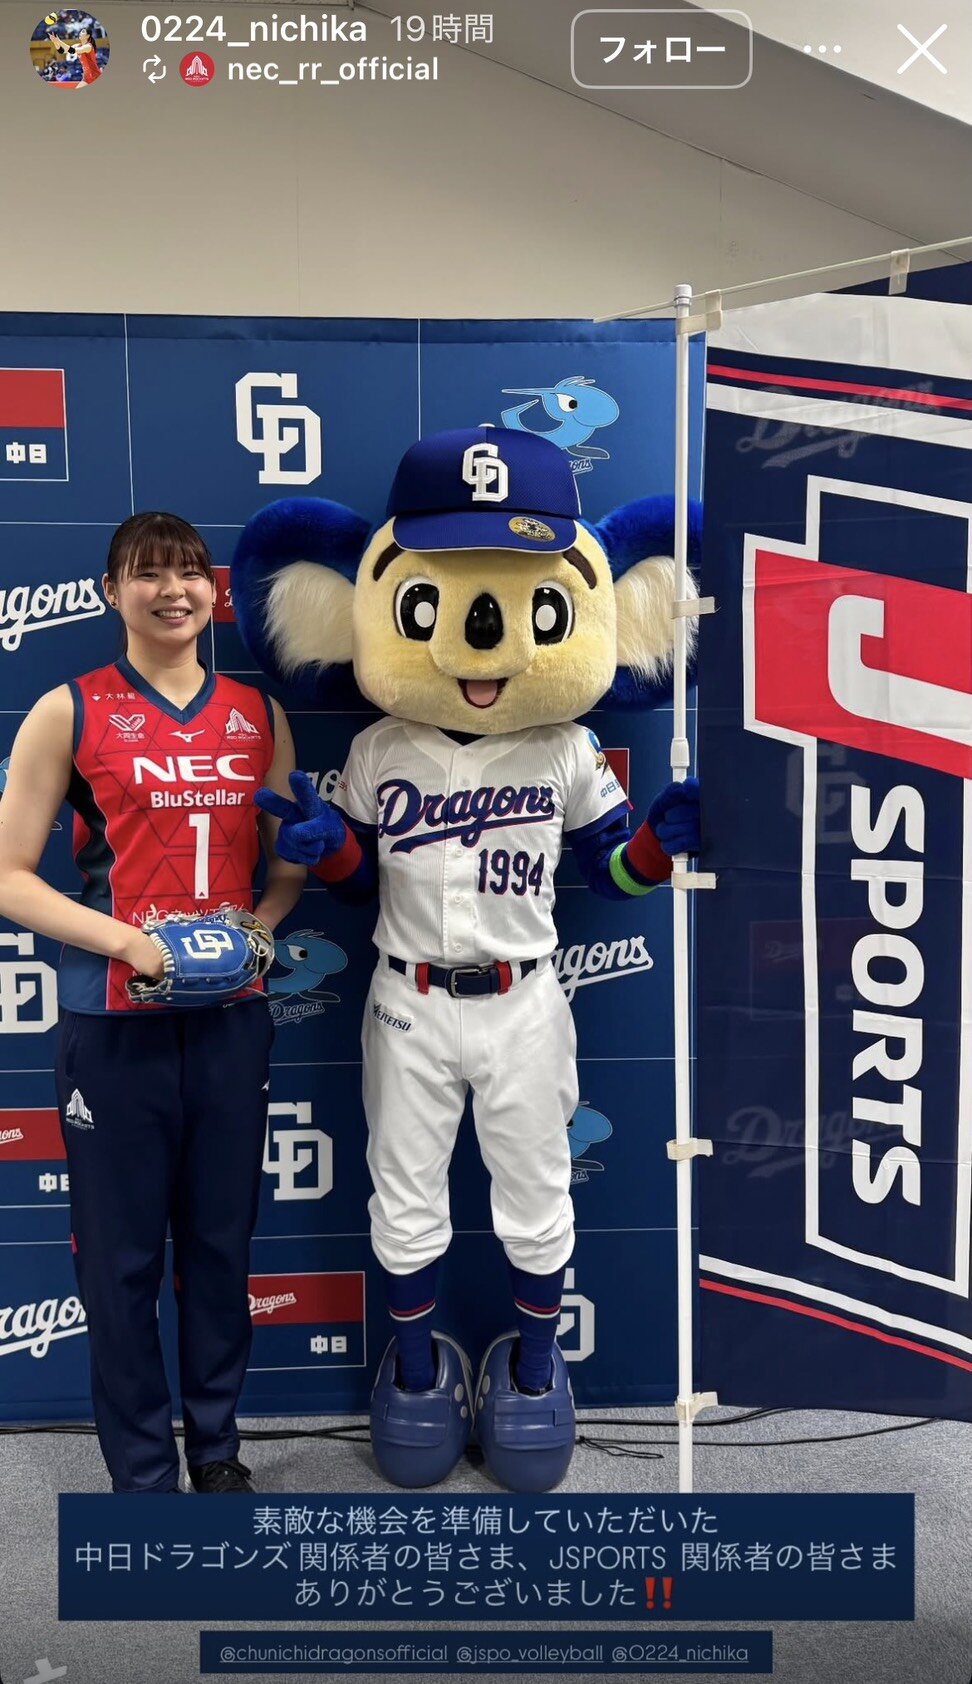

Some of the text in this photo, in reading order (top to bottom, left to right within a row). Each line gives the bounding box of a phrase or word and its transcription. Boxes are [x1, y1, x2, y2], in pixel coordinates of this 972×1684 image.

[6, 442, 47, 464] 中日
[133, 754, 255, 785] NEC
[150, 789, 246, 809] BluStellar
[378, 778, 555, 854] Dragons
[189, 813, 210, 900] 1
[478, 848, 545, 896] 1994
[851, 784, 925, 1207] SPORTS
[310, 1334, 347, 1354] 中日
